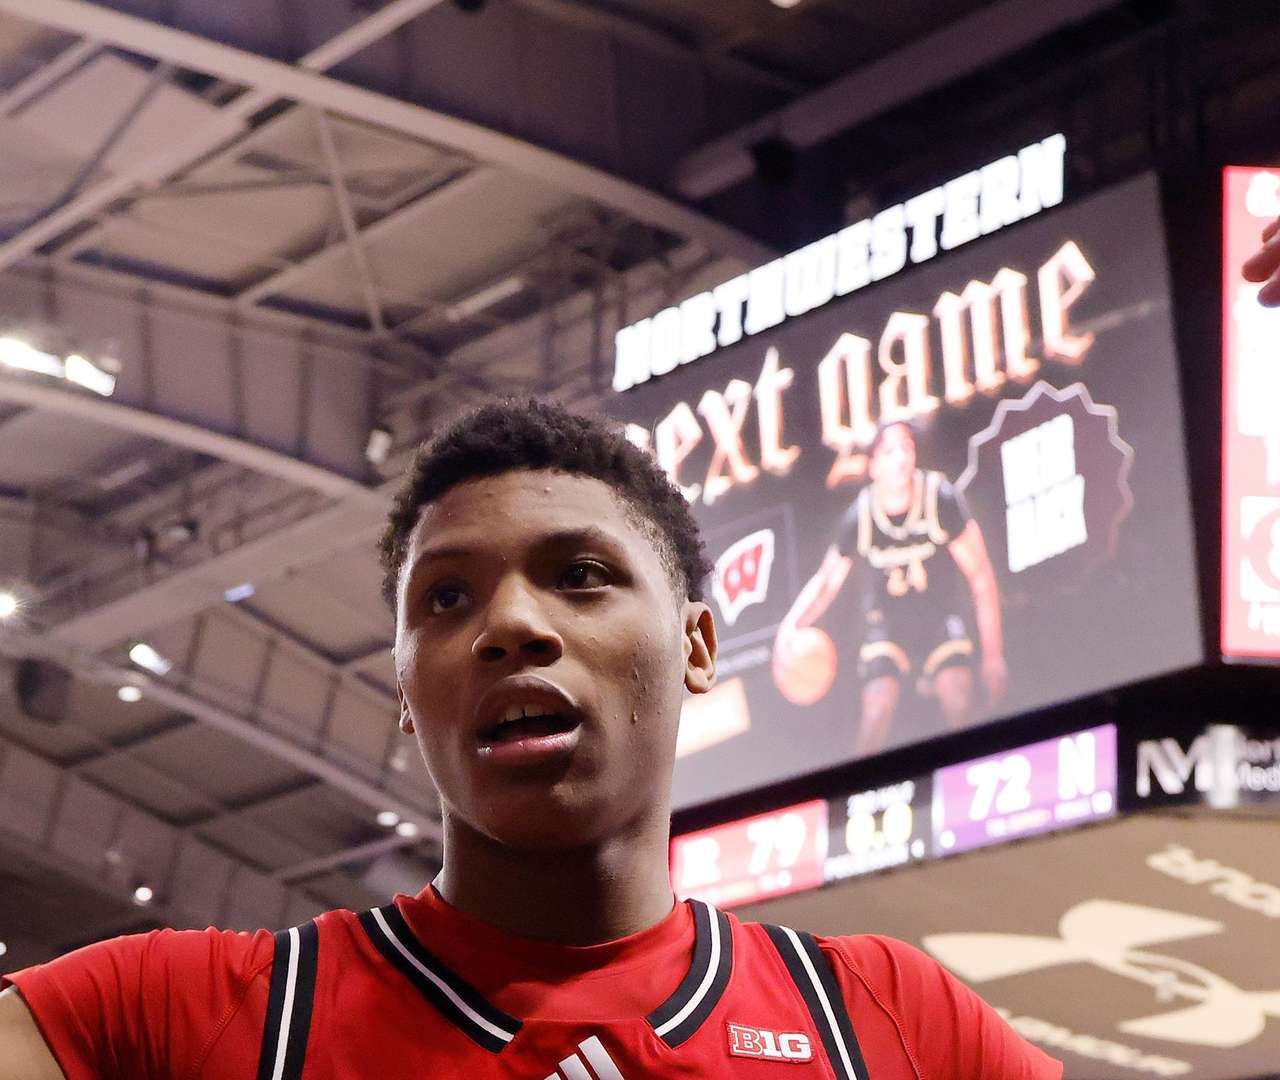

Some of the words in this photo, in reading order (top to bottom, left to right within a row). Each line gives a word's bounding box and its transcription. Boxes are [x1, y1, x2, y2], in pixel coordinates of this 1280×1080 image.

[612, 132, 1066, 393] NORTHWESTERN
[624, 346, 801, 506] ext
[967, 753, 1033, 821] 72
[1058, 731, 1097, 800] N
[746, 813, 807, 875] 79
